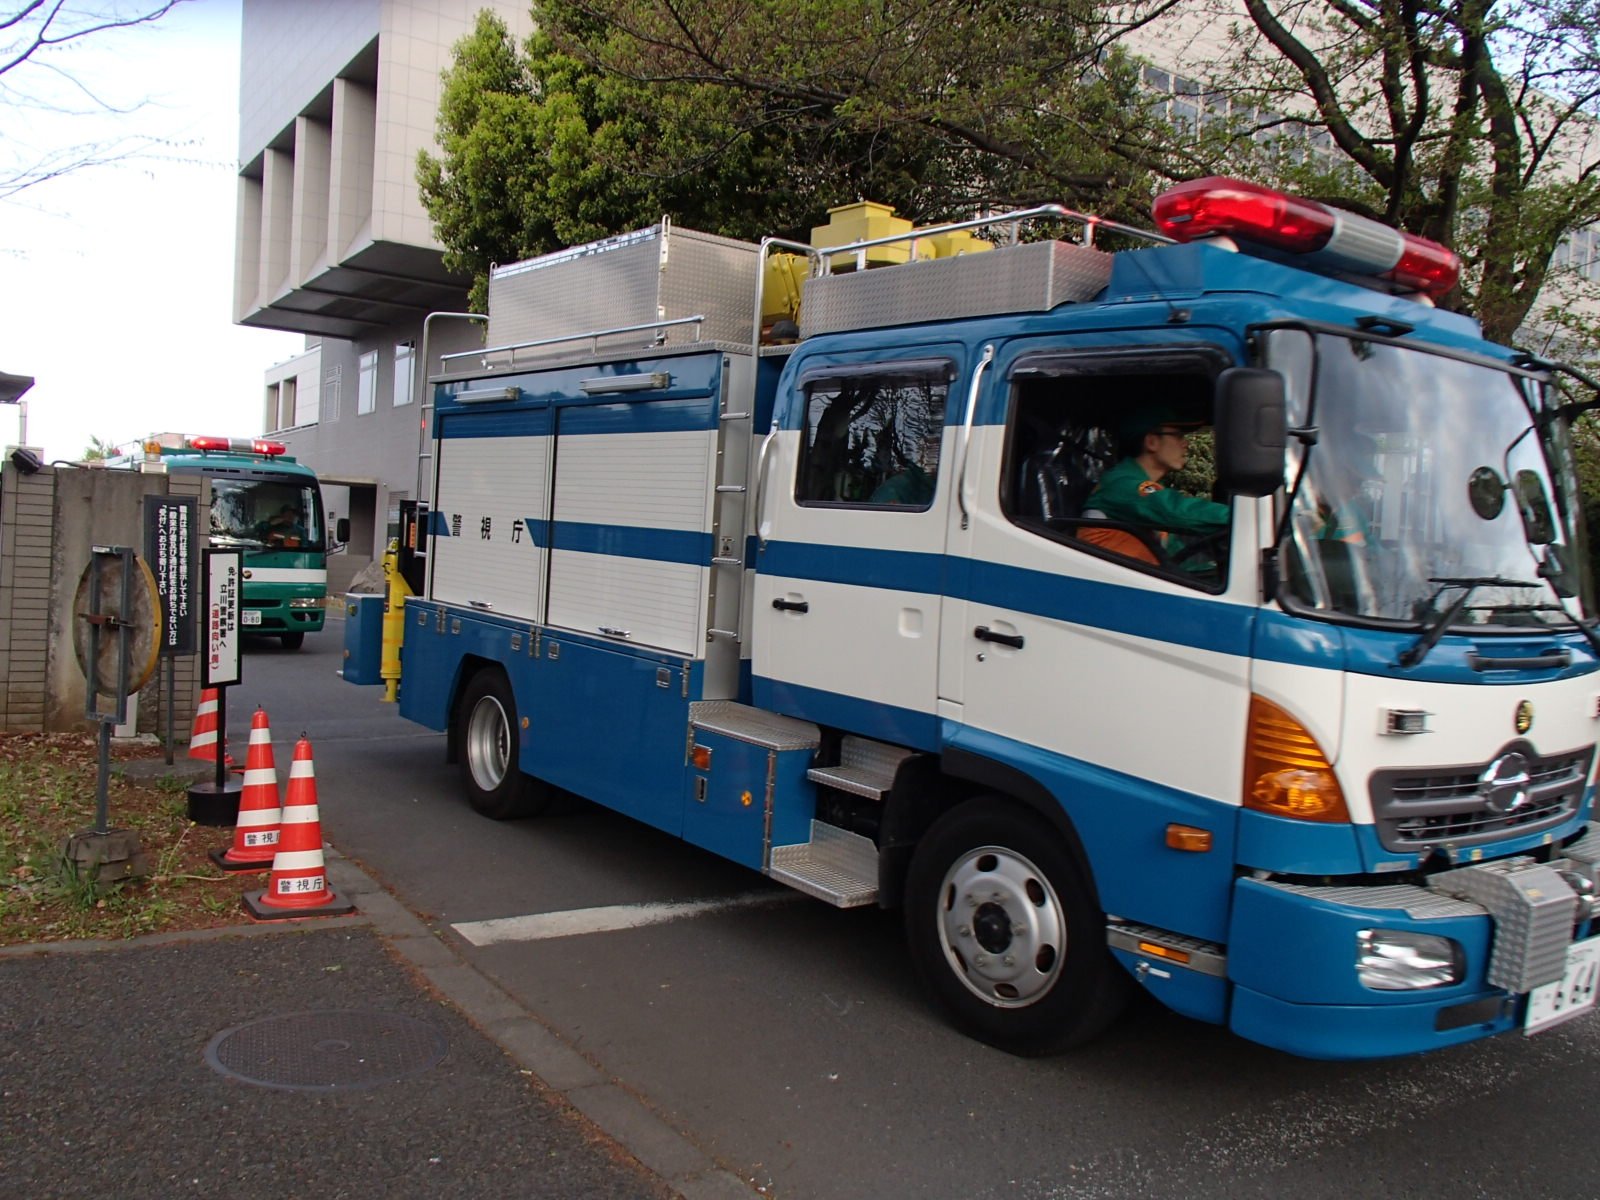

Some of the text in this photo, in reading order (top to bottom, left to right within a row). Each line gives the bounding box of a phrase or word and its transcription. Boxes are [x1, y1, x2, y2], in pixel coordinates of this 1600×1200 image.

[452, 514, 524, 544] 警視庁
[227, 566, 236, 632] 免許証更新は
[219, 584, 228, 648] 立川警察署へ
[243, 615, 260, 623] 0-80
[280, 878, 323, 892] 警視庁
